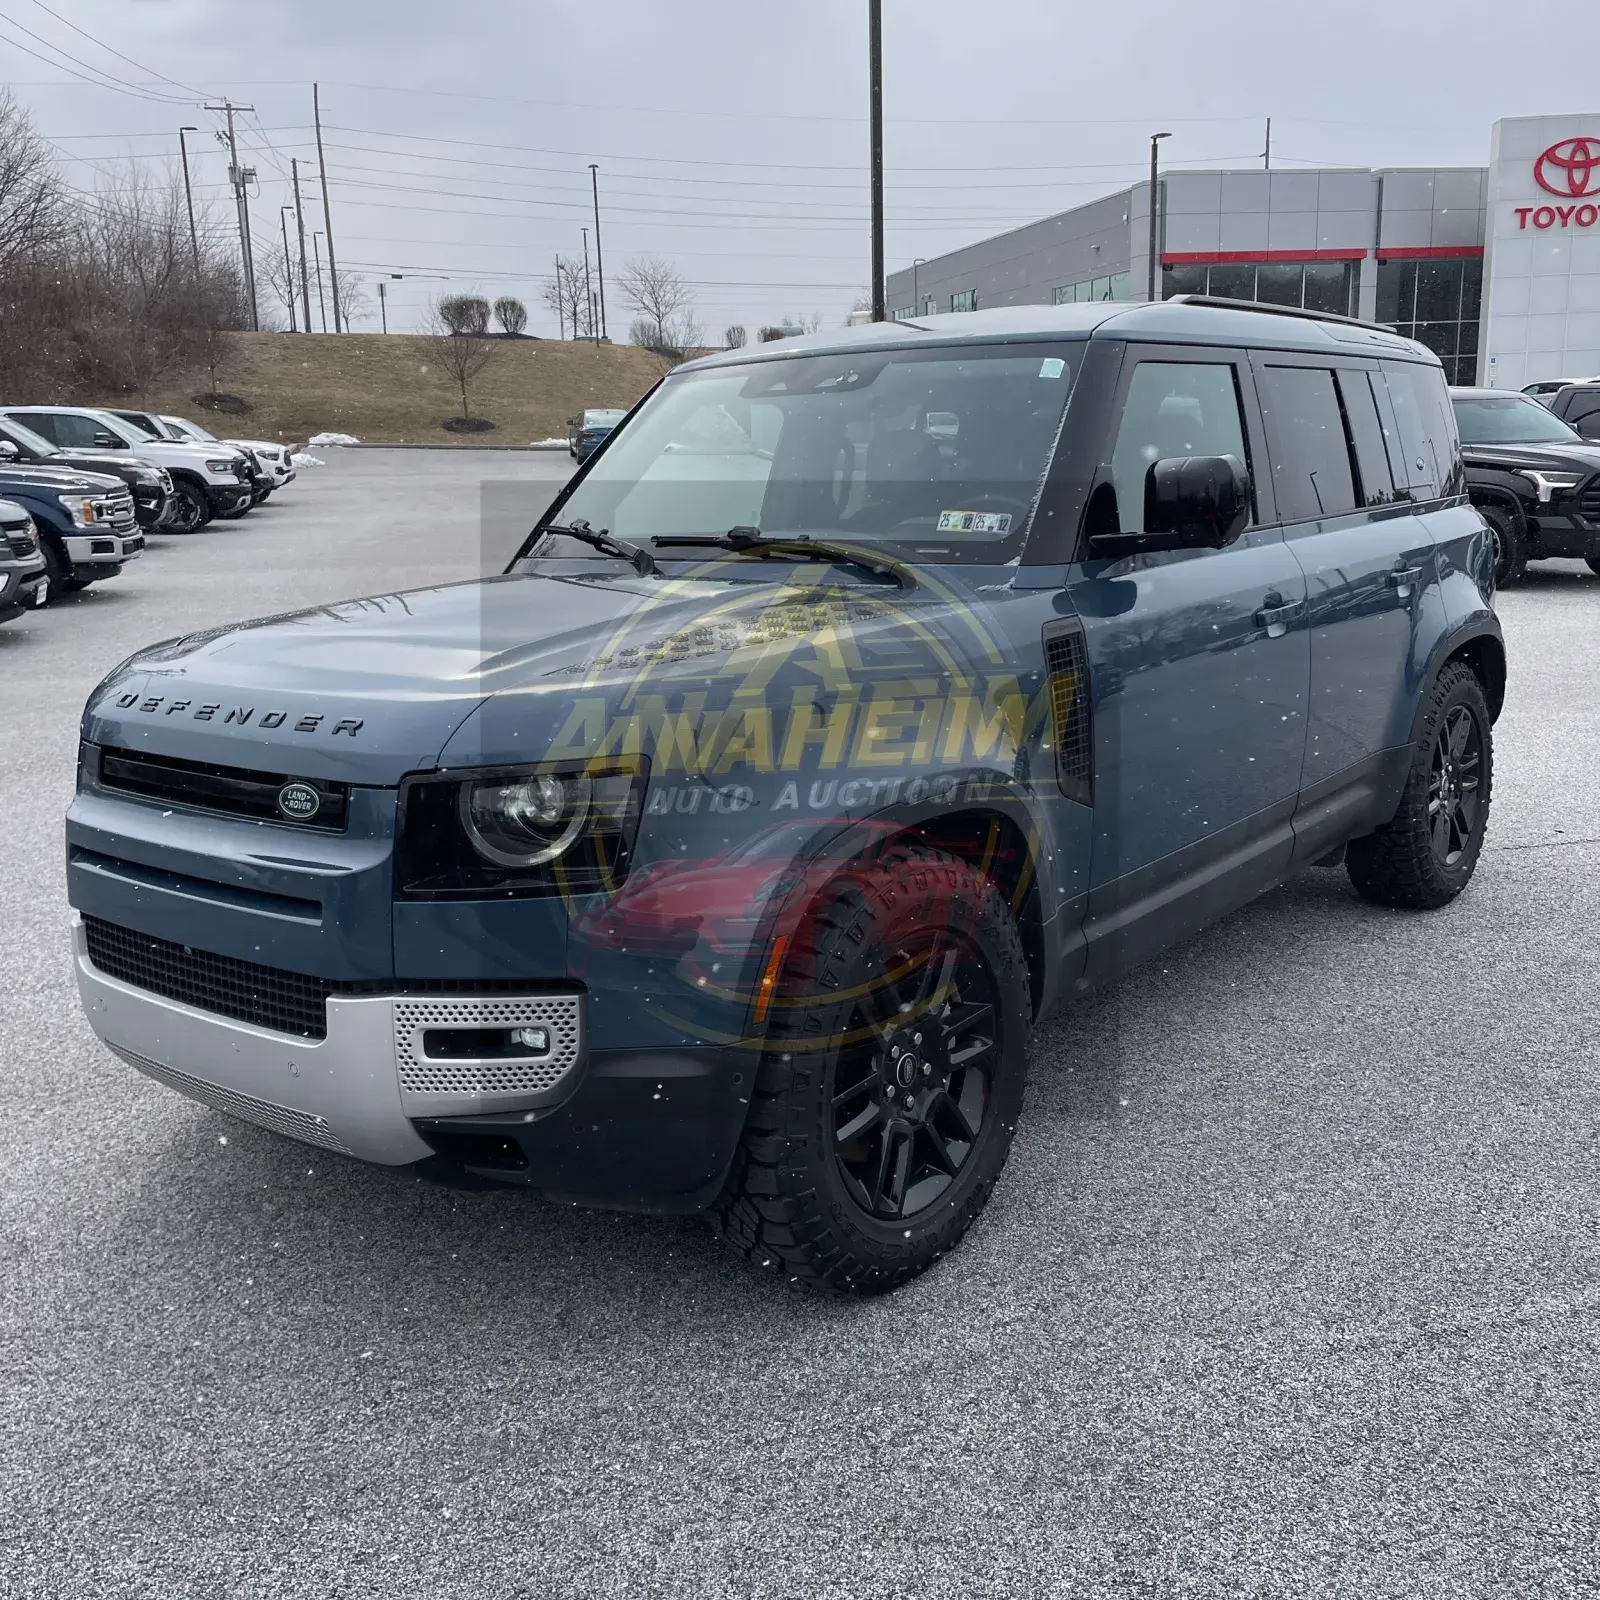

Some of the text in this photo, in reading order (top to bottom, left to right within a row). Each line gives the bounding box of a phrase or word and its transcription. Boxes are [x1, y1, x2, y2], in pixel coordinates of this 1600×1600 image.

[1514, 204, 1600, 229] TOYO
[939, 513, 951, 527] 25
[975, 514, 985, 529] 25
[115, 693, 364, 737] DEFENDER
